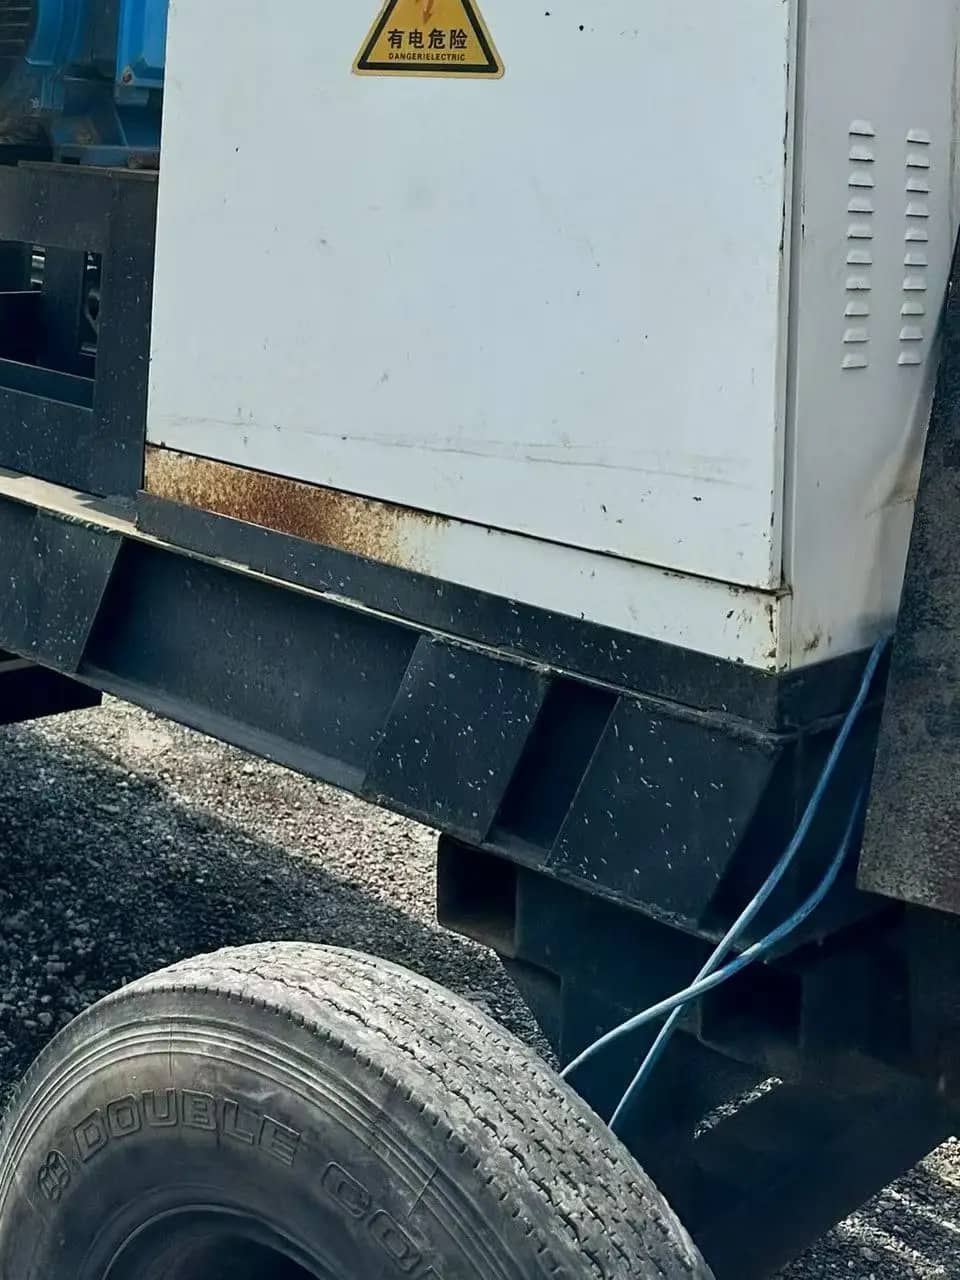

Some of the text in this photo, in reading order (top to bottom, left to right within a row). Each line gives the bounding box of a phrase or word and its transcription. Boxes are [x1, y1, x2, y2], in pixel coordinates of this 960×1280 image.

[387, 28, 468, 49] 有电危险
[73, 1087, 446, 1280] DOUBLE CO
